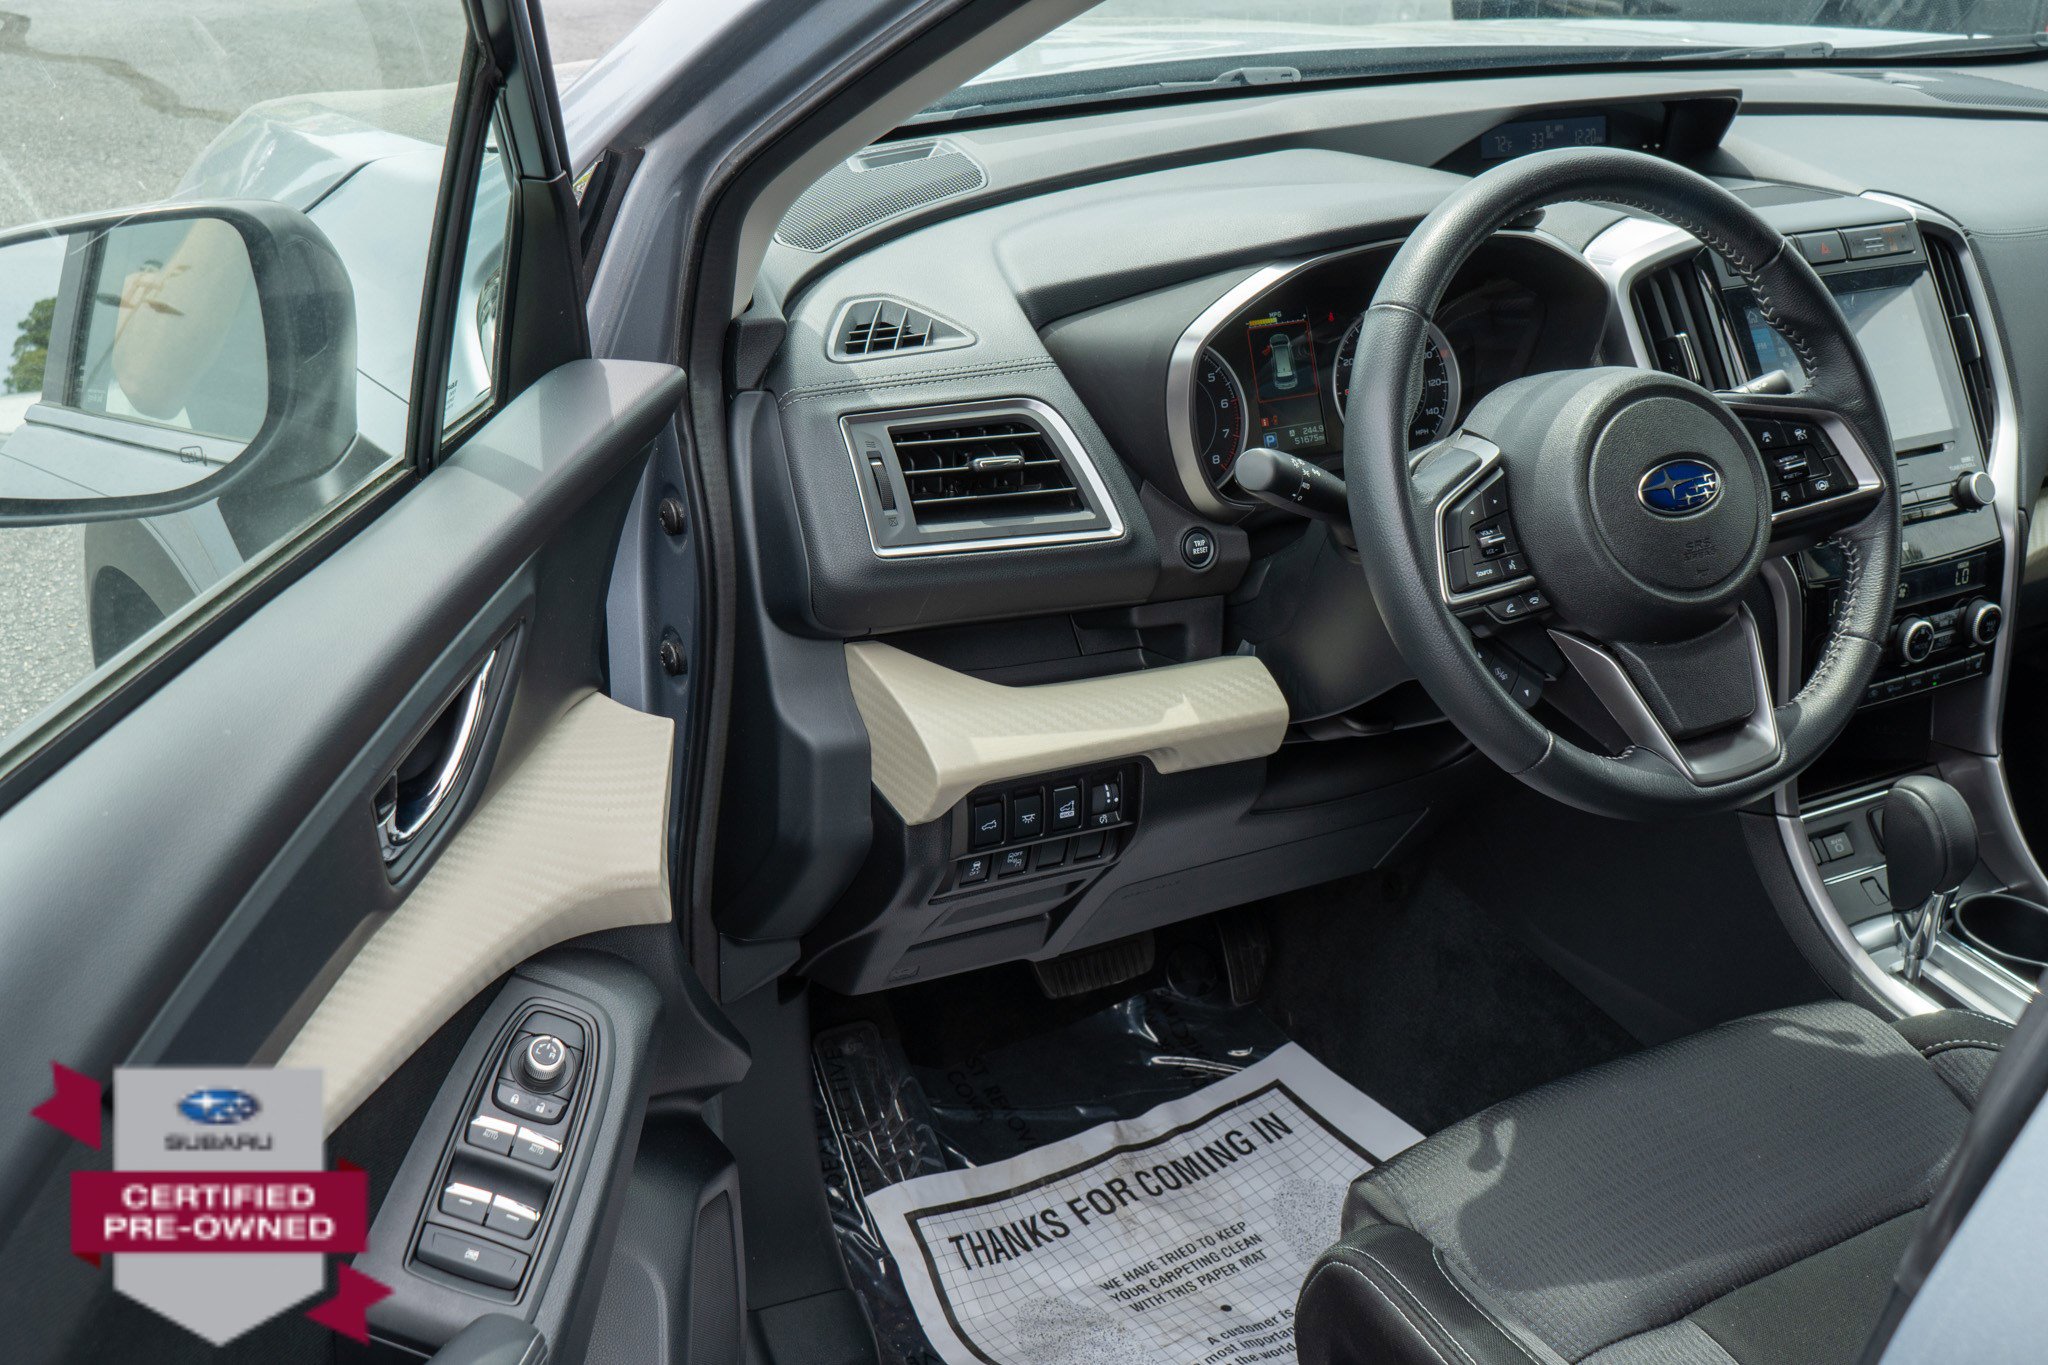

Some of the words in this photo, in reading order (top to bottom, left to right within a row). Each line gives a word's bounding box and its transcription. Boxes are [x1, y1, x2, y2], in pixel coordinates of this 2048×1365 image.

[1207, 372, 1216, 382] 5
[1427, 379, 1442, 387] 120
[1220, 398, 1229, 408] 6
[1425, 406, 1440, 415] 140
[1222, 428, 1230, 438] 7
[1302, 424, 1324, 435] 244.9
[1415, 428, 1429, 436] MPH
[1212, 454, 1221, 465] 8
[1193, 539, 1206, 547] TRIP
[1192, 546, 1209, 555] RESET
[1476, 567, 1493, 577] Source
[483, 1130, 499, 1140] AUTO
[529, 1145, 544, 1155] AUTO
[948, 1208, 1071, 1271] THANKS
[1066, 1177, 1140, 1226] FOR
[1134, 1129, 1258, 1197] COMING
[1249, 1111, 1294, 1144] IN
[1100, 1276, 1124, 1292] WE
[1122, 1260, 1159, 1283] HAVE
[1157, 1243, 1198, 1267] TRIED
[1196, 1235, 1216, 1250] TO
[1215, 1221, 1247, 1242] KEEP
[1110, 1283, 1151, 1303] YOUR
[1150, 1251, 1221, 1290] CARPETING
[1220, 1233, 1263, 1258] CLEAN
[1129, 1293, 1167, 1313] WITH
[1165, 1280, 1198, 1301] THIS
[1197, 1262, 1241, 1287] PAPER
[1239, 1249, 1268, 1269] MAT
[1207, 1336, 1220, 1346] A
[1220, 1315, 1279, 1340] customer
[1278, 1308, 1295, 1320] is
[1204, 1343, 1240, 1365] most
[1239, 1326, 1295, 1348] importan
[1234, 1353, 1259, 1365] the
[1259, 1342, 1297, 1360] world
